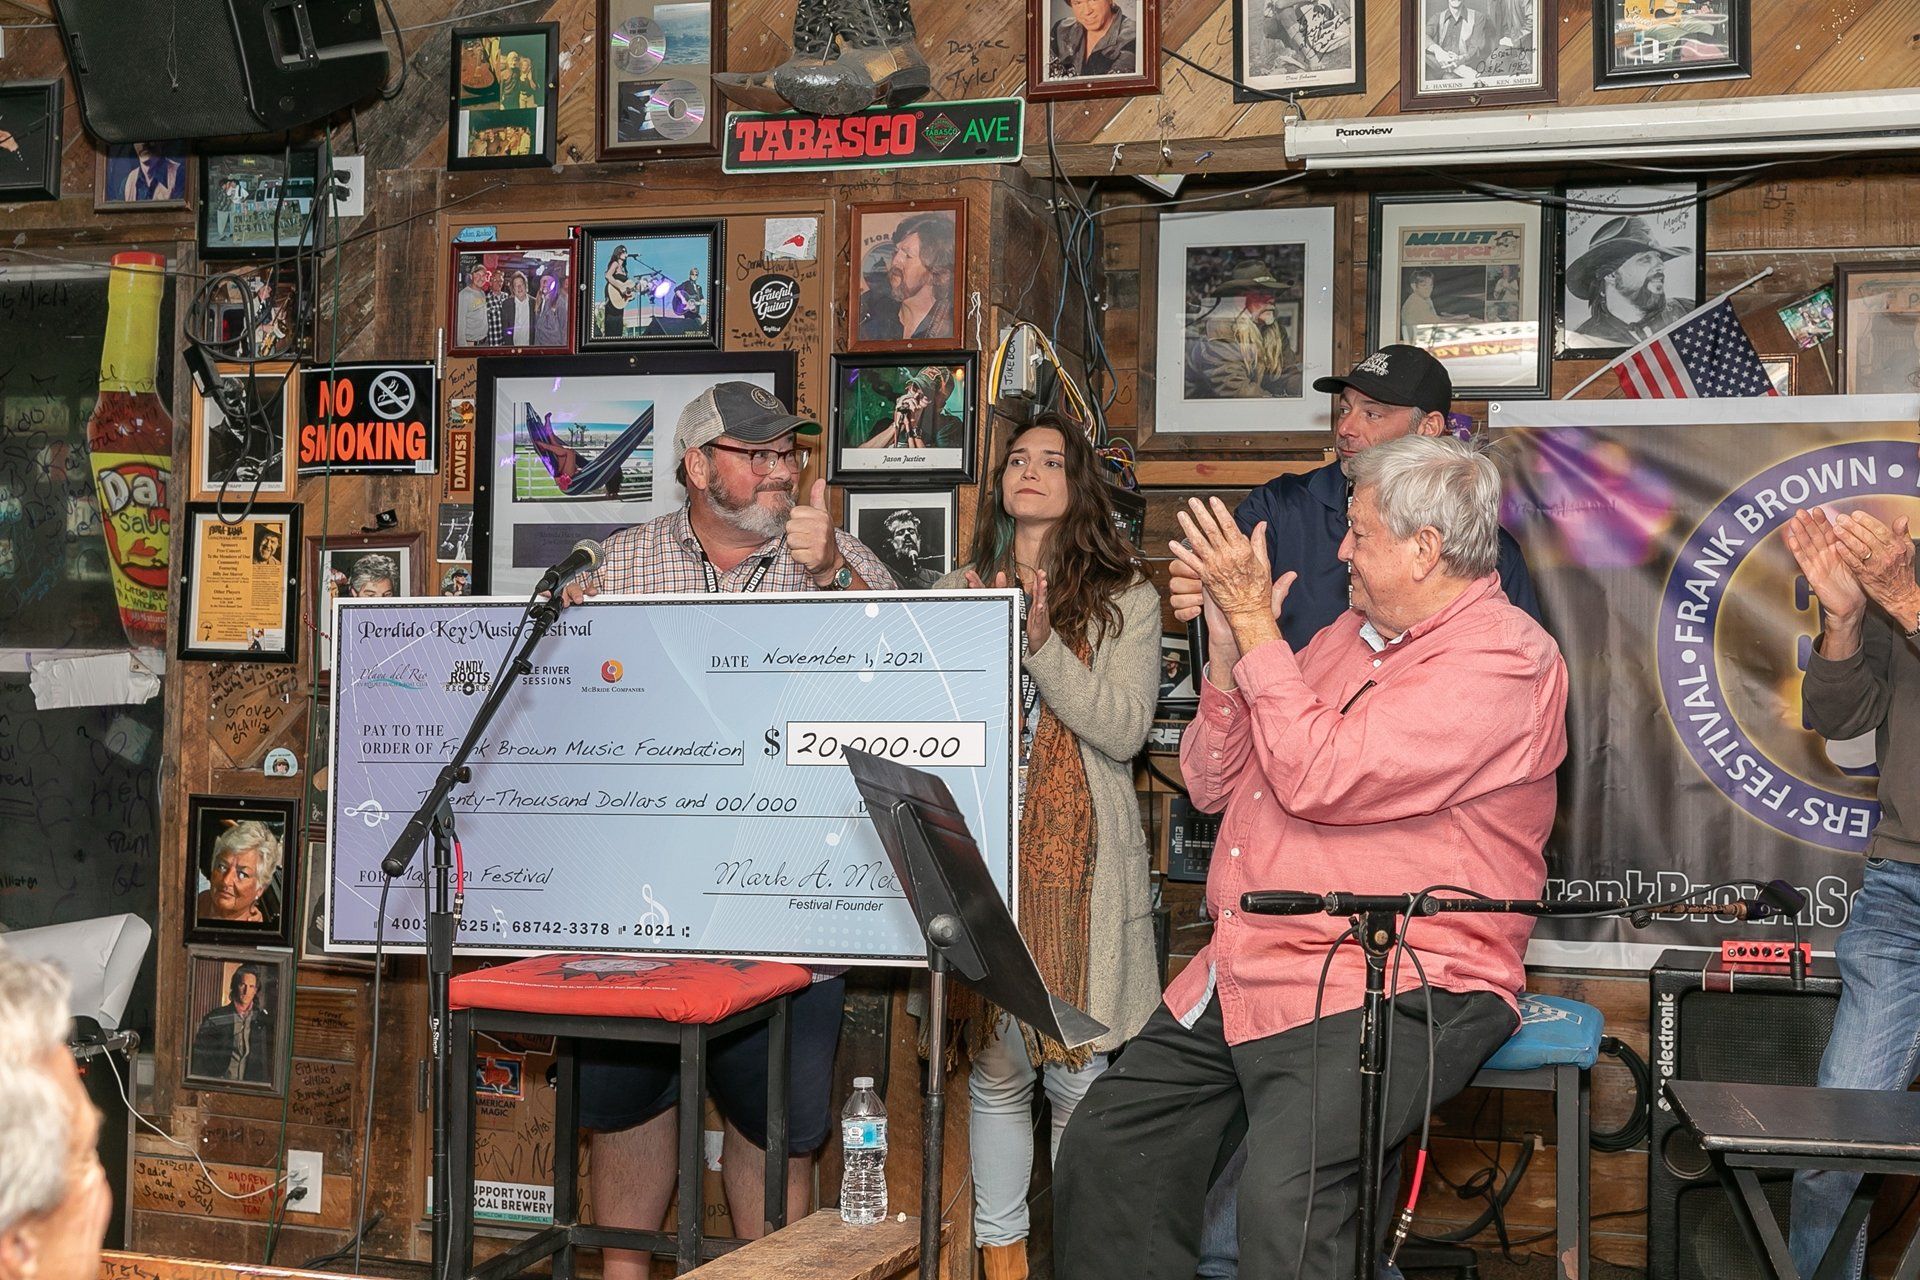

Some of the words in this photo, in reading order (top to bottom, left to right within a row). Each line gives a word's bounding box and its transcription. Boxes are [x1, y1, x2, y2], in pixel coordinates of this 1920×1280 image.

[946, 67, 997, 98] Tyler
[735, 113, 917, 162] TABASCO
[962, 116, 1014, 144] AVE.
[924, 127, 959, 138] TABASCO
[1335, 126, 1393, 137] Panoview
[1405, 230, 1498, 246] MULLET
[752, 280, 794, 310] Grateful
[757, 300, 790, 321] Guitar
[1003, 339, 1016, 386] JUKEBOX
[318, 378, 355, 419] NO
[300, 421, 427, 464] SMOKING
[454, 439, 468, 489] DAVIS
[882, 454, 902, 464] Jason
[902, 454, 926, 464] Justice
[1675, 524, 1746, 643] FRANK
[1733, 456, 1878, 535] BROWN
[358, 621, 425, 644] Perdido
[430, 620, 468, 644] Key
[468, 620, 520, 641] Music
[454, 660, 484, 673] SANDY
[711, 655, 750, 668] DATE
[762, 646, 856, 667] November
[865, 652, 874, 668] 1,
[882, 651, 923, 667] 2021
[450, 672, 491, 685] ROOTS
[542, 666, 570, 675] RIVER
[522, 677, 572, 685] SESSIONS
[224, 704, 284, 720] Grover
[363, 724, 388, 737] PAY
[391, 724, 411, 737] TO
[415, 724, 444, 737] THE
[1677, 664, 1792, 811] FESTIVAL
[362, 742, 410, 755] ORDER
[415, 742, 433, 755] OF
[438, 737, 491, 758] Frnk
[497, 740, 557, 756] Brown
[565, 739, 626, 757] Music
[634, 737, 742, 758] Foundation
[764, 725, 781, 759] $
[797, 732, 961, 759] 20,000.00
[417, 788, 591, 812] Tenty-Thousand
[595, 790, 668, 809] Dollars
[675, 793, 708, 809] and
[715, 793, 797, 813] 00/000
[359, 870, 386, 883] FOR
[395, 865, 427, 888] May
[480, 864, 554, 885] Festival
[714, 858, 795, 889] Mark
[798, 859, 832, 889] A.
[788, 898, 833, 910] Festival
[835, 899, 884, 911] Founder
[512, 921, 610, 935] 68742-3378
[633, 923, 676, 937] 2021
[1656, 993, 1674, 1077] electronic
[475, 1098, 516, 1109] AMERICAN
[480, 1107, 508, 1117] MAGIC
[155, 1177, 175, 1189] and
[227, 1171, 269, 1186] ANDREW
[142, 1184, 176, 1202] Scout
[187, 1190, 214, 1215] Josh
[516, 1189, 546, 1201] YOUR
[501, 1199, 553, 1214] BREWERY
